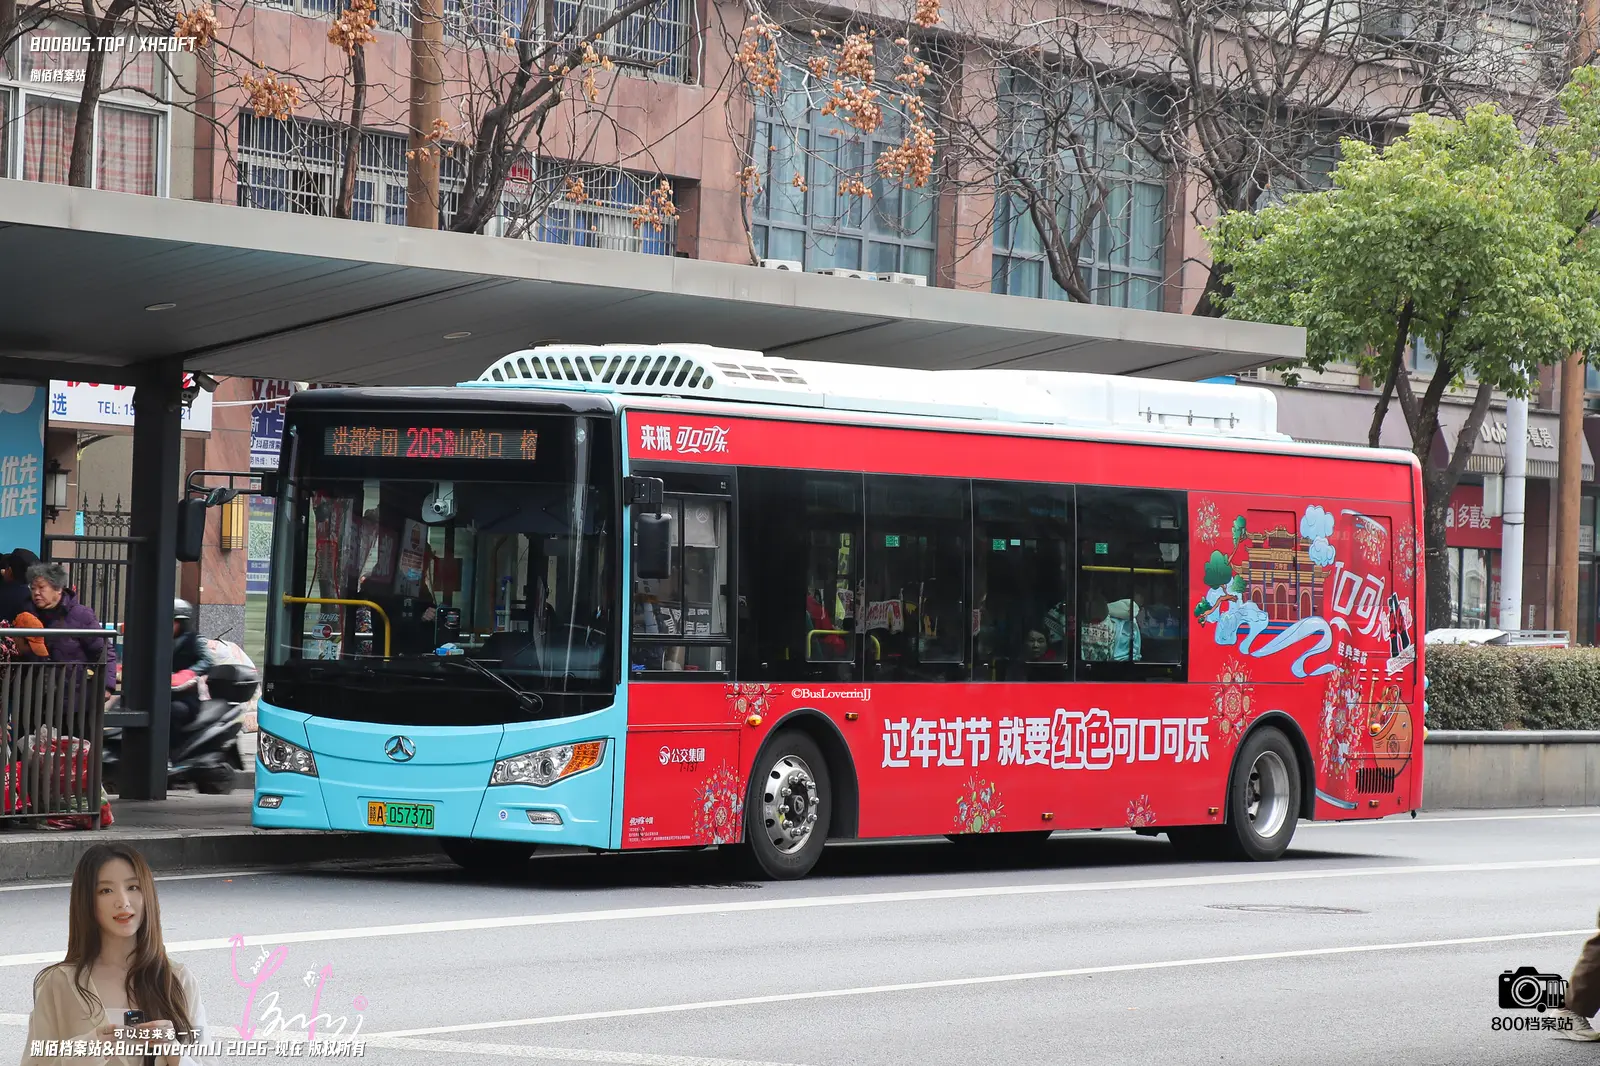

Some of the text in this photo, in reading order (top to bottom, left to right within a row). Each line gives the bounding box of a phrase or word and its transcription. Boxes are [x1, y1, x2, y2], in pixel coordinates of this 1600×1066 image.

[52, 393, 67, 416] 选
[97, 400, 121, 415] TEL:
[640, 424, 731, 454] 来瓶 可口可乐
[1, 453, 38, 486] 优先
[1, 485, 38, 519] 优先
[882, 708, 1210, 770] 过年过节 就要红色可口可乐
[671, 748, 705, 763] 公交集团
[389, 806, 433, 826] 05737D
